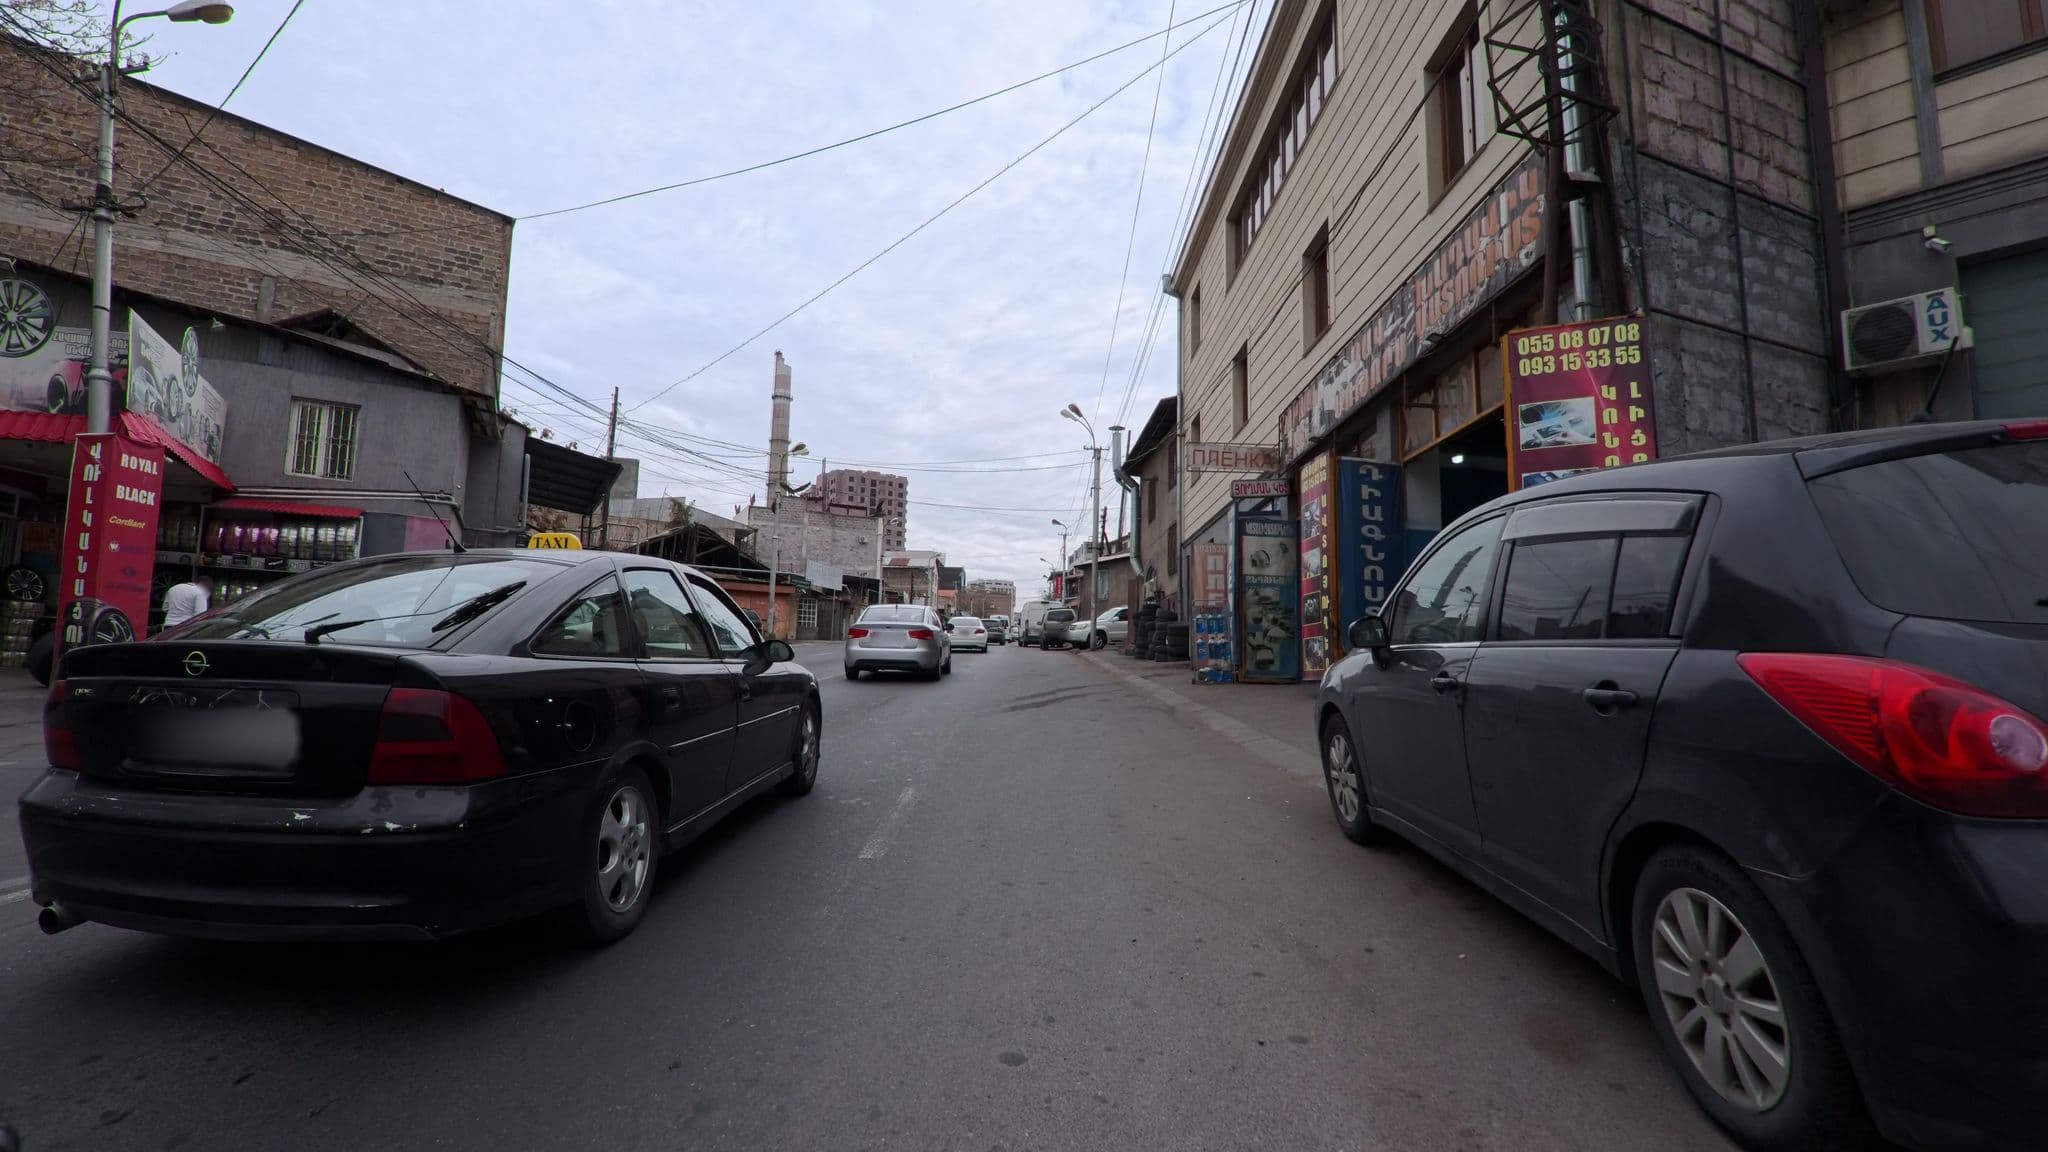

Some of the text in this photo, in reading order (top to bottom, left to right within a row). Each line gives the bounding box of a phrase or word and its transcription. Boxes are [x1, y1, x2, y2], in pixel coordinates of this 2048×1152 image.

[1926, 296, 1950, 343] AUX
[1517, 322, 1640, 356] 055 08 07 08
[1518, 344, 1641, 377] 093 15 33 55
[120, 453, 159, 476] ROYAL
[1191, 446, 1274, 469] ПЛЁНКА
[115, 484, 156, 507] BLACK
[107, 514, 146, 530] Cordiant
[533, 536, 569, 549] TAXI
